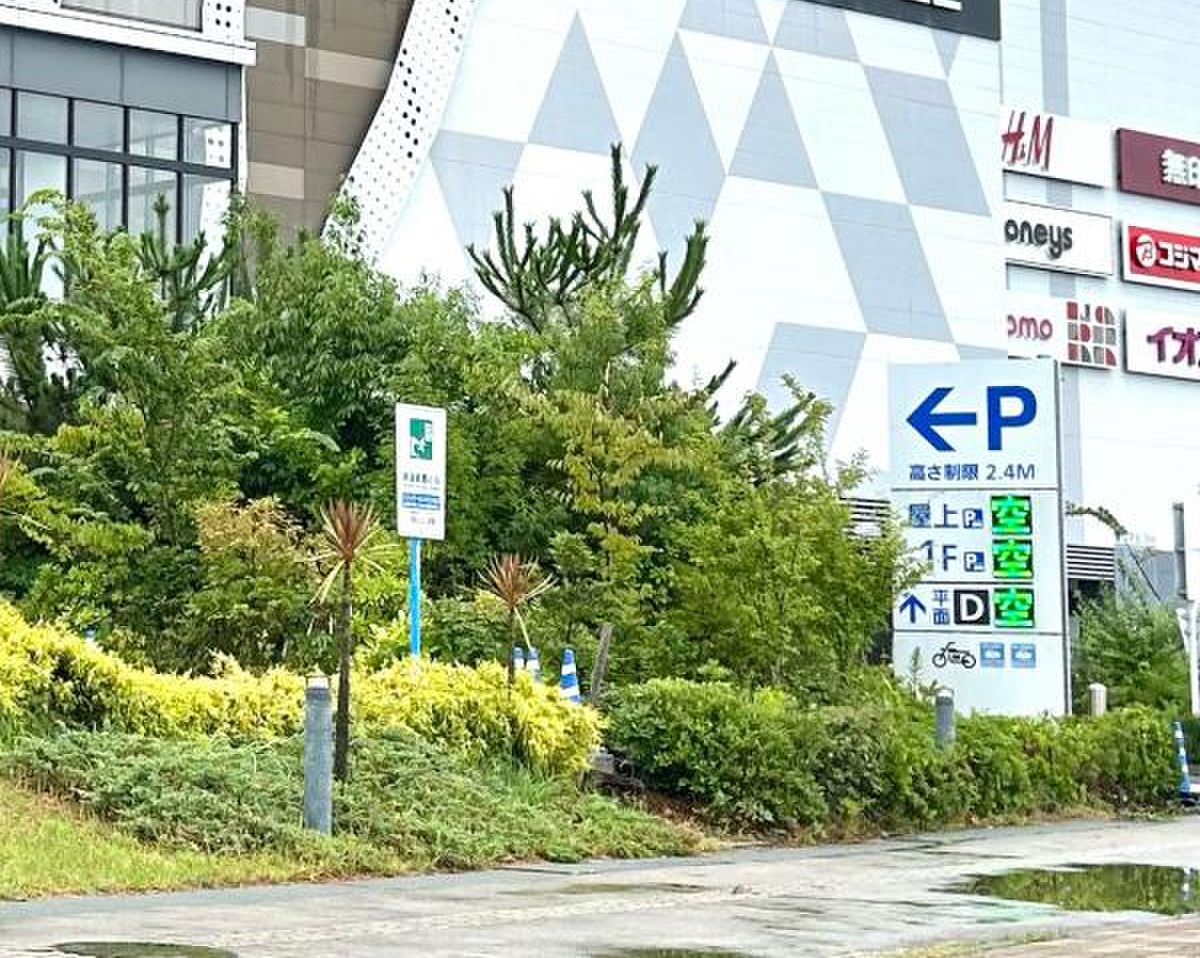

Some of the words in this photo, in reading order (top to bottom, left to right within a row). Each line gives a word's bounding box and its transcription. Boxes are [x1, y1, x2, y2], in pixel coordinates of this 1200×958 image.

[987, 386, 1038, 451] P
[909, 463, 978, 481] 高さ制限
[986, 463, 1035, 481] 2.4M
[909, 503, 958, 529] 屋上
[920, 540, 957, 572] 1F
[933, 589, 950, 625] 平面
[959, 593, 985, 622] D
